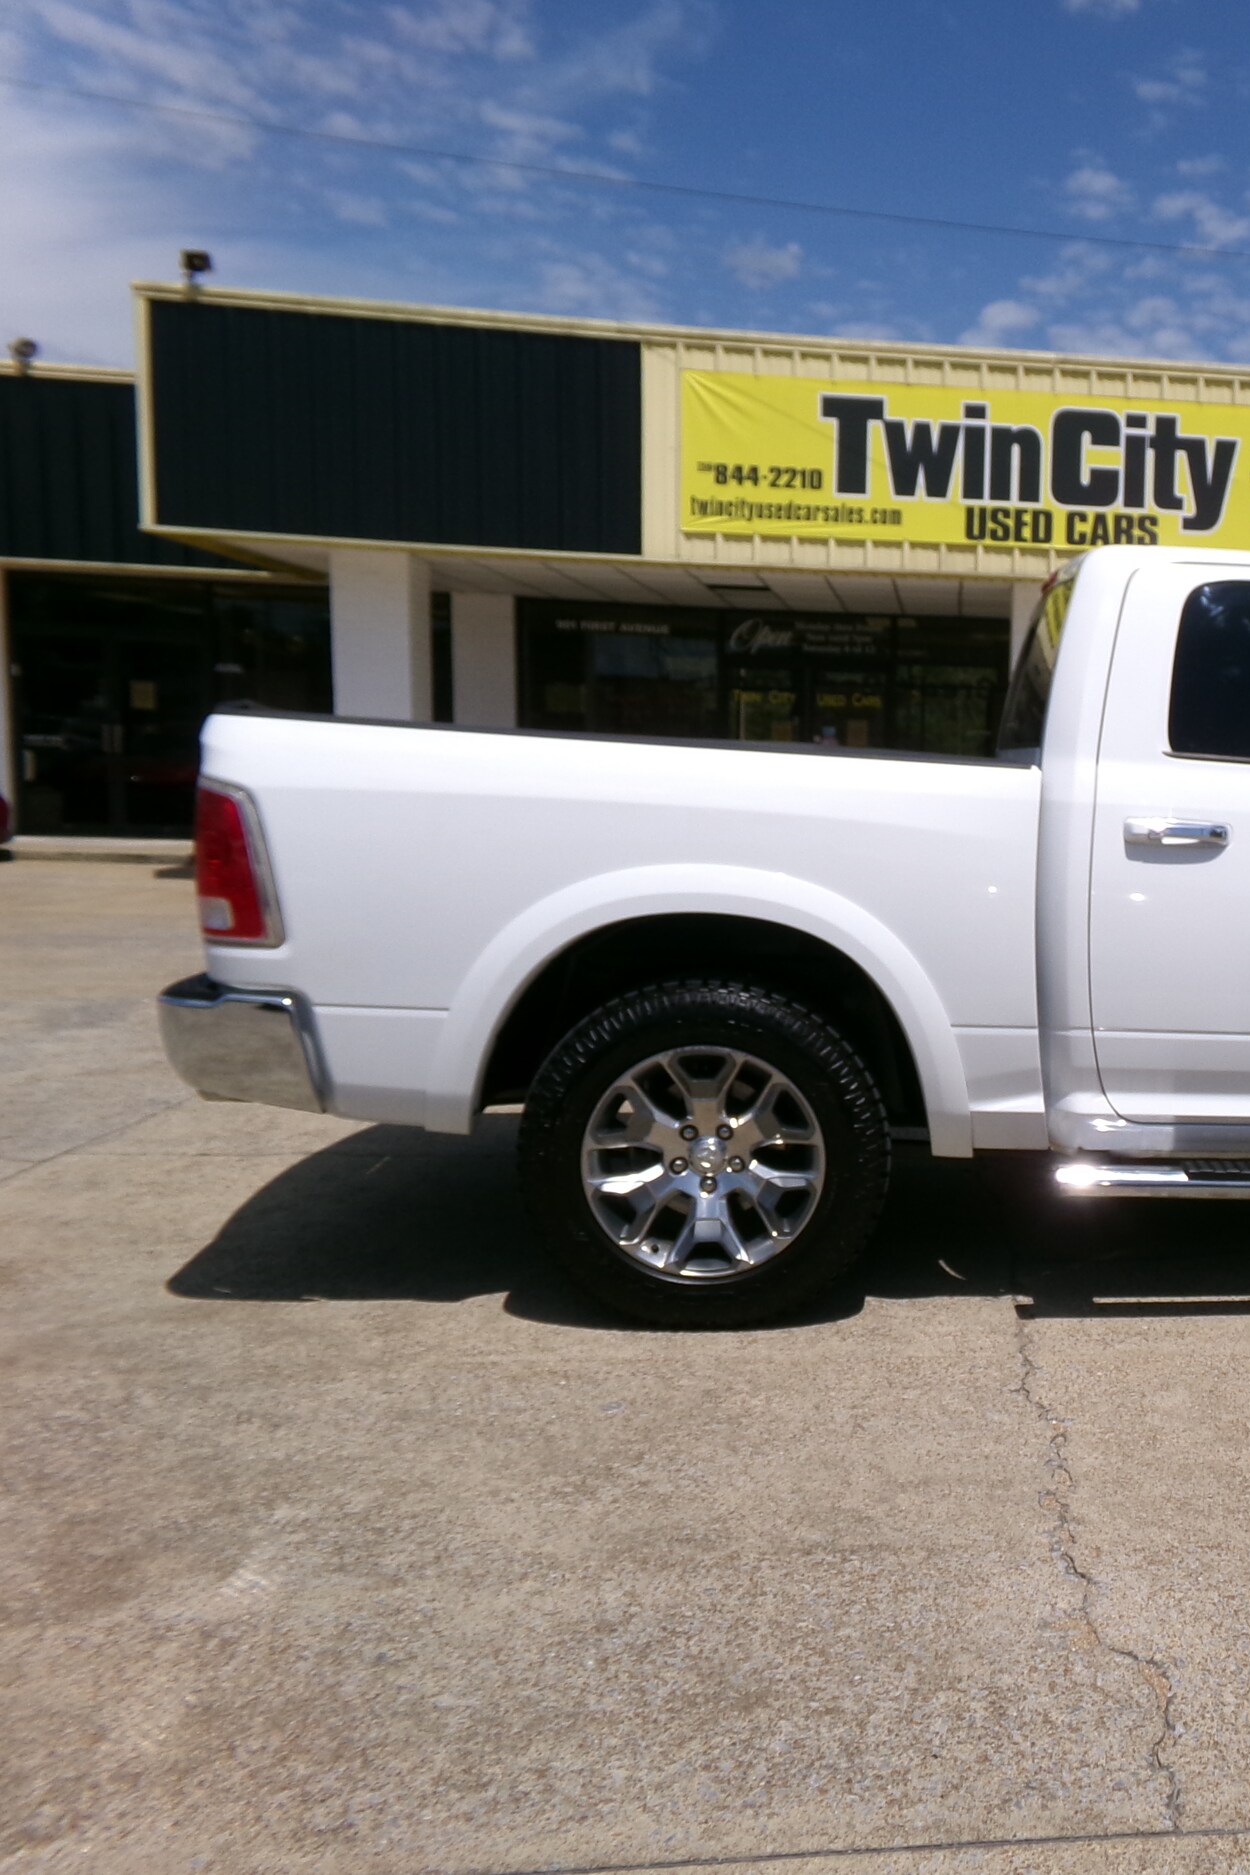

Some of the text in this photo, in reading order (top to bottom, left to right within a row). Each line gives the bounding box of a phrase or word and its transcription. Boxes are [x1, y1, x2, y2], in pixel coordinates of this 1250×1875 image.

[714, 463, 823, 490] 844-2210
[820, 393, 1240, 534] Twin City
[965, 506, 1159, 546] USED CARS
